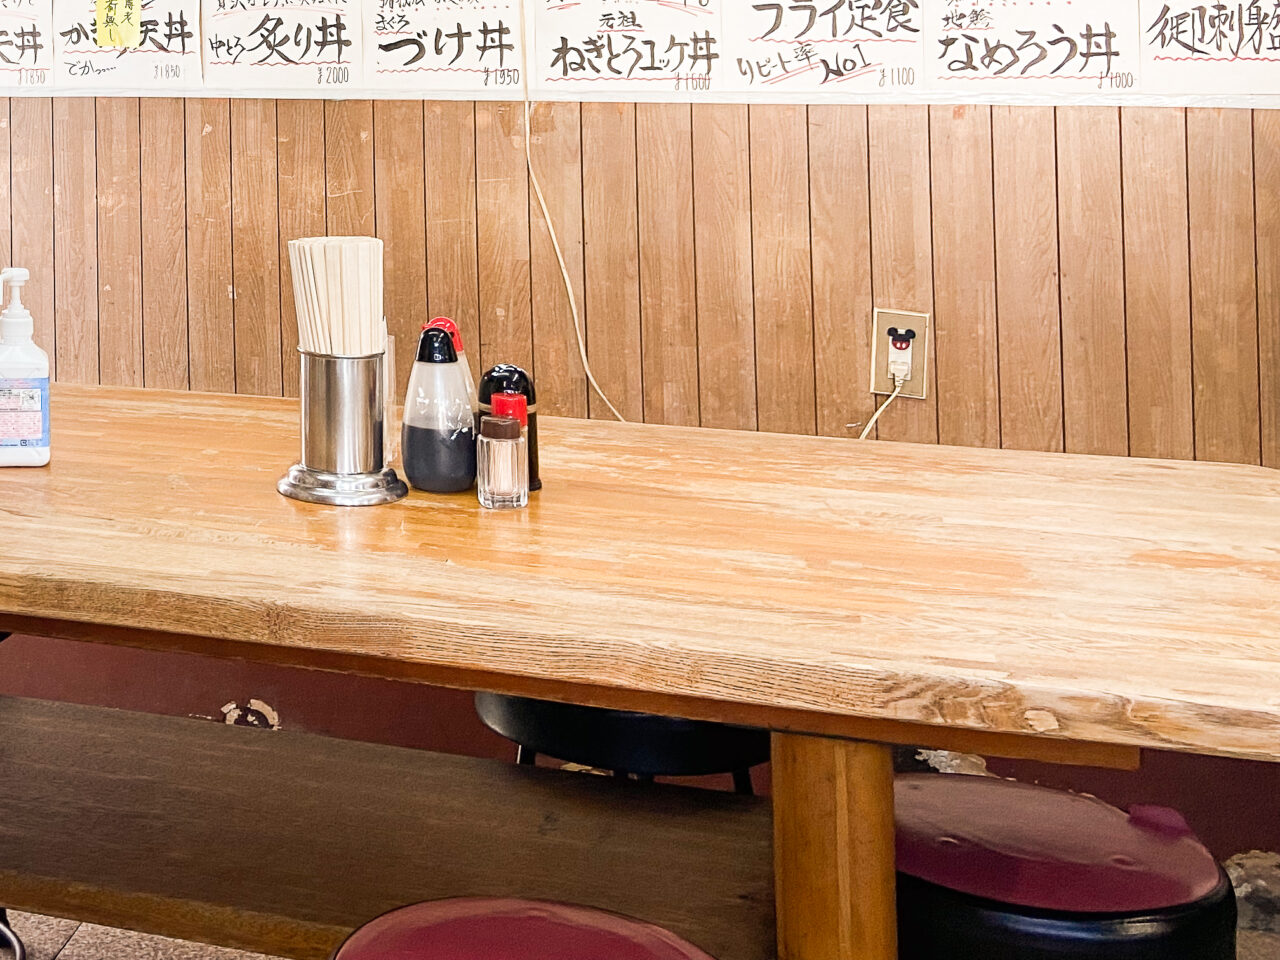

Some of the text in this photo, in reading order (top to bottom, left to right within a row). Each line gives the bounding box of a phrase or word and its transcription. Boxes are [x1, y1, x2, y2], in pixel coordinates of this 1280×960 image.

[246, 13, 353, 66] 炙り丼
[378, 19, 516, 67] づけ丼
[549, 30, 719, 81] ねぎとろユッケ丼
[936, 22, 1121, 77] なめろう丼
